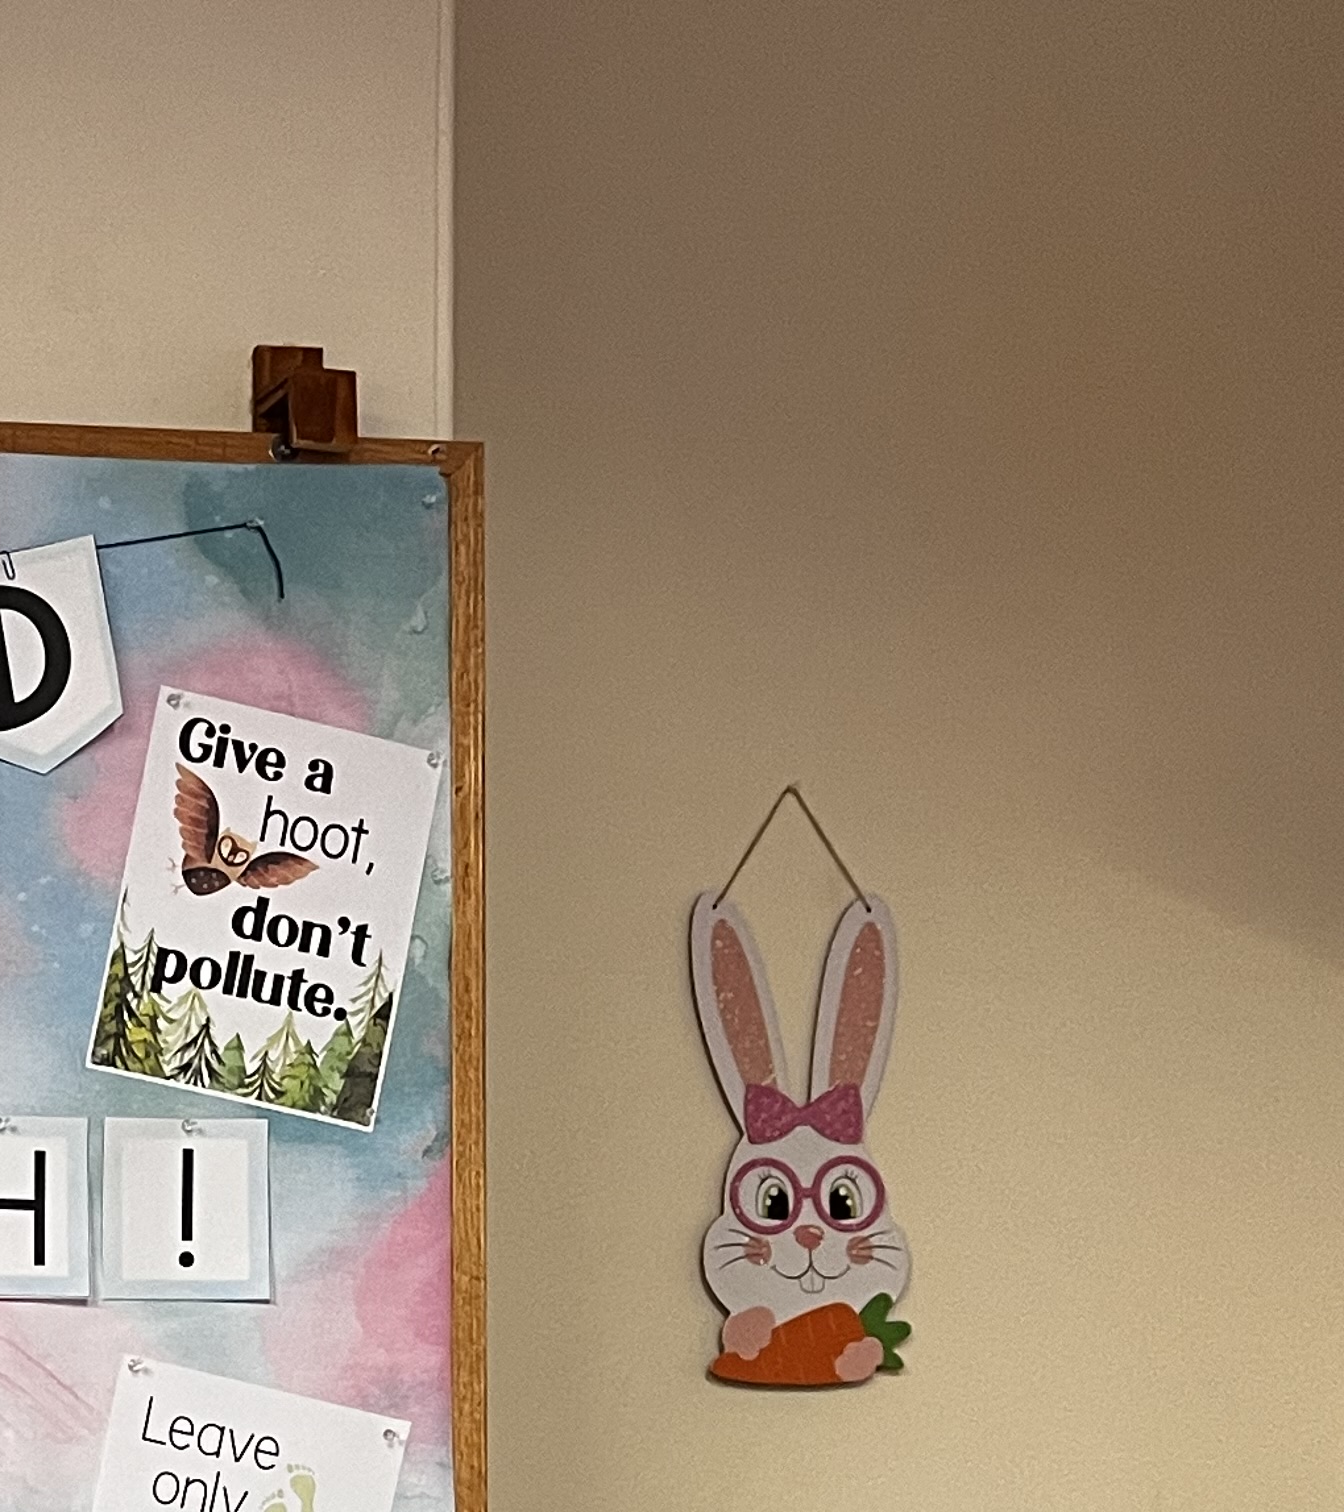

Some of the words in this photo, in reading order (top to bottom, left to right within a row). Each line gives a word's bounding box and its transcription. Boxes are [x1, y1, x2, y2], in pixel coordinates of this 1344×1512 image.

[178, 717, 286, 782] Give
[304, 758, 334, 795] a
[260, 795, 375, 875] hoot,
[231, 897, 371, 967] don't
[151, 945, 348, 1022] pollute.
[140, 1395, 281, 1471] Leave
